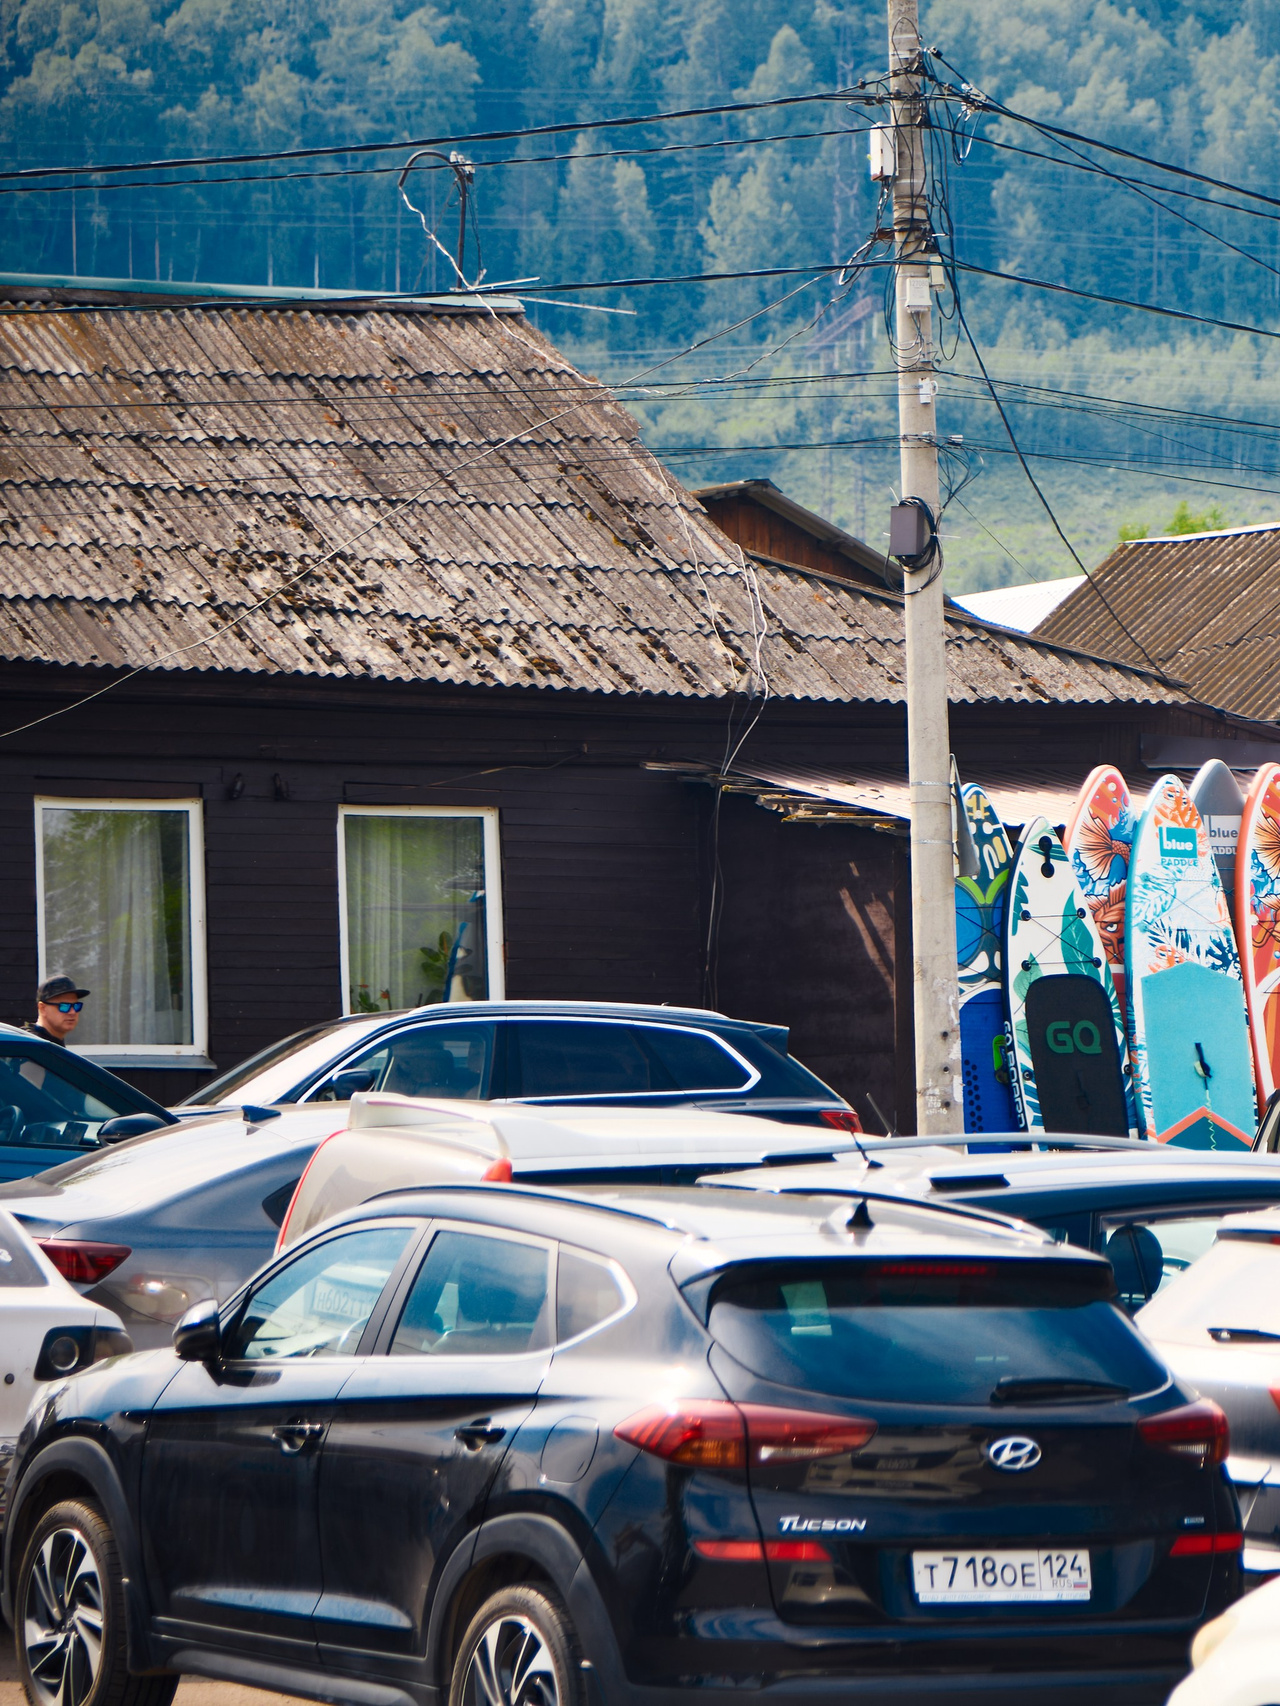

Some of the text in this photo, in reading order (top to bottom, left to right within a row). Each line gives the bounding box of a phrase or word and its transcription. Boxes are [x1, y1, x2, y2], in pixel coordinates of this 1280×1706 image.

[1162, 827, 1193, 851] blue
[1211, 846, 1237, 855] ADDL
[1160, 857, 1198, 867] PADDLE
[780, 1515, 867, 1532] TUCSON
[1042, 1553, 1083, 1579] 124
[1052, 1580, 1073, 1588] RUS
